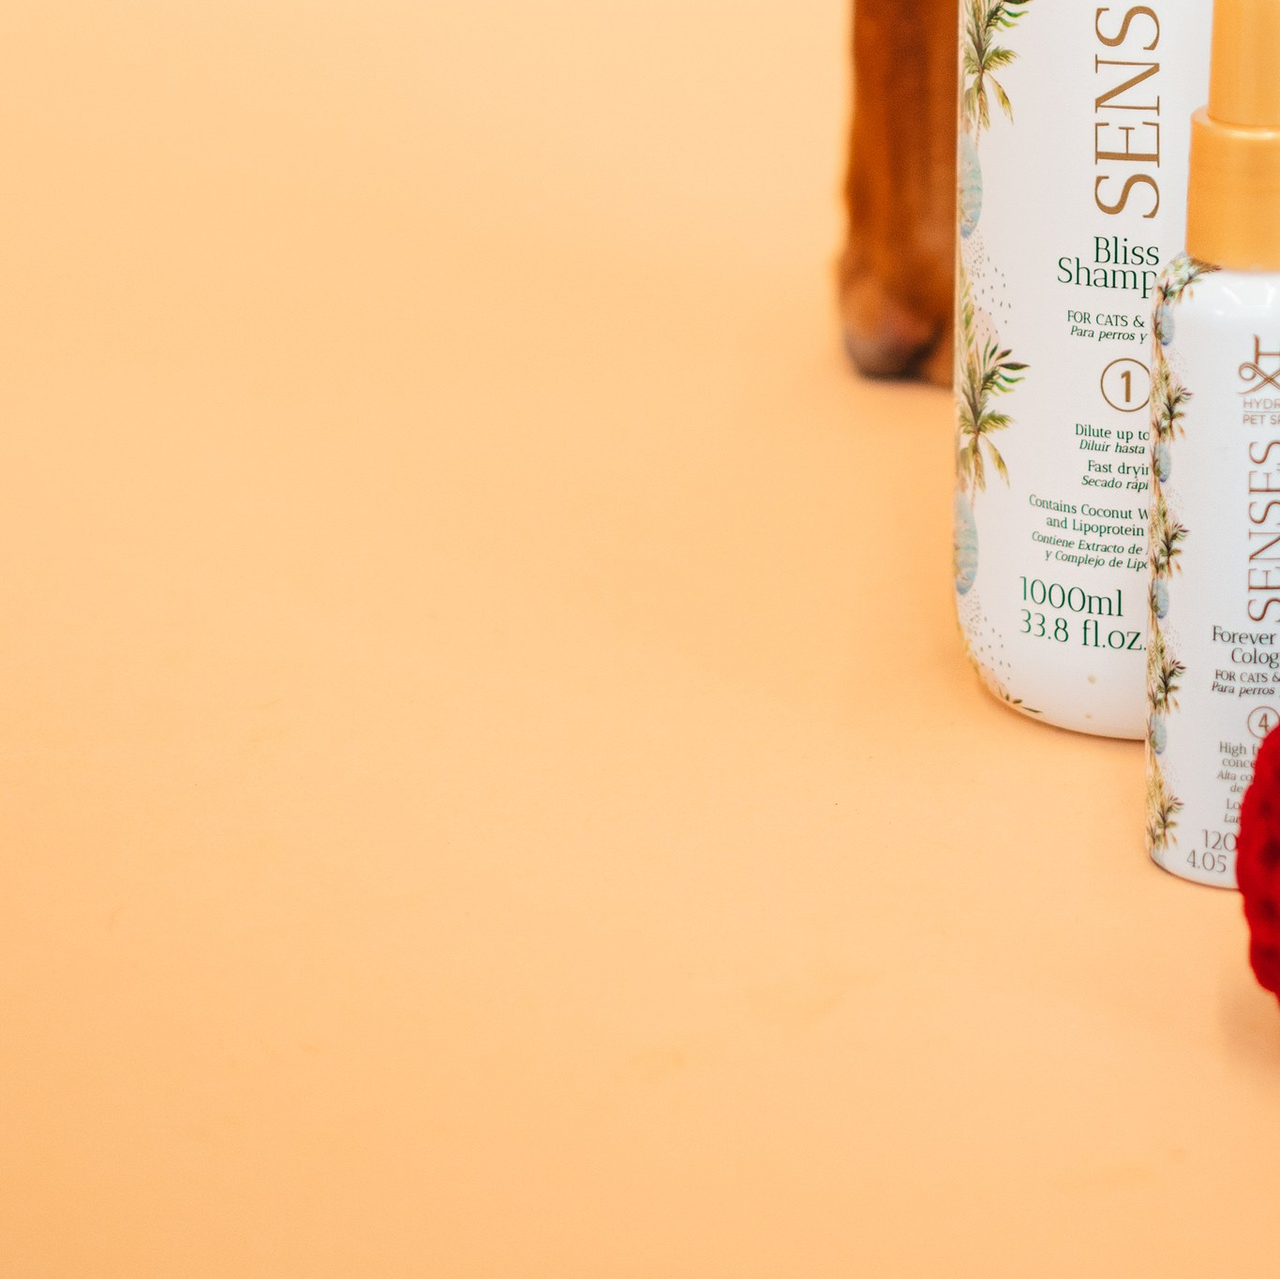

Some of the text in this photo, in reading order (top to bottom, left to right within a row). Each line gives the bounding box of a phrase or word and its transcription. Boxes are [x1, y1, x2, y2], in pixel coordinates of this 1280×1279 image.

[1093, 235, 1160, 267] Bliss
[1067, 309, 1146, 329] FOR CATS &
[1069, 324, 1149, 345] Para perros y
[1120, 370, 1132, 403] 1
[1242, 414, 1266, 425] PET
[1074, 423, 1150, 444] Dilute up to
[1078, 438, 1146, 455] Diluir hasta
[1087, 459, 1113, 474] Fast
[1080, 474, 1123, 490] Secado
[1028, 493, 1078, 515] Contains
[1080, 503, 1133, 520] Coconut
[1045, 516, 1145, 538] and Lipoprotein
[1031, 530, 1143, 555] Contiene Extracto de
[1044, 549, 1053, 562] y
[1054, 549, 1106, 569] Complejo
[1108, 556, 1124, 568] de
[1019, 575, 1124, 617] 1000ml
[1020, 608, 1147, 651] 33.8 fl.oz.
[1212, 624, 1278, 645] Forever
[1215, 668, 1237, 682] FOR
[1239, 671, 1268, 684] CATS
[1211, 681, 1235, 694] Para
[1238, 685, 1276, 698] perros
[1257, 712, 1270, 733] 4
[1219, 740, 1247, 758] High
[1216, 769, 1237, 781] Alta
[1229, 783, 1244, 793] de
[1186, 848, 1228, 874] 4.05
